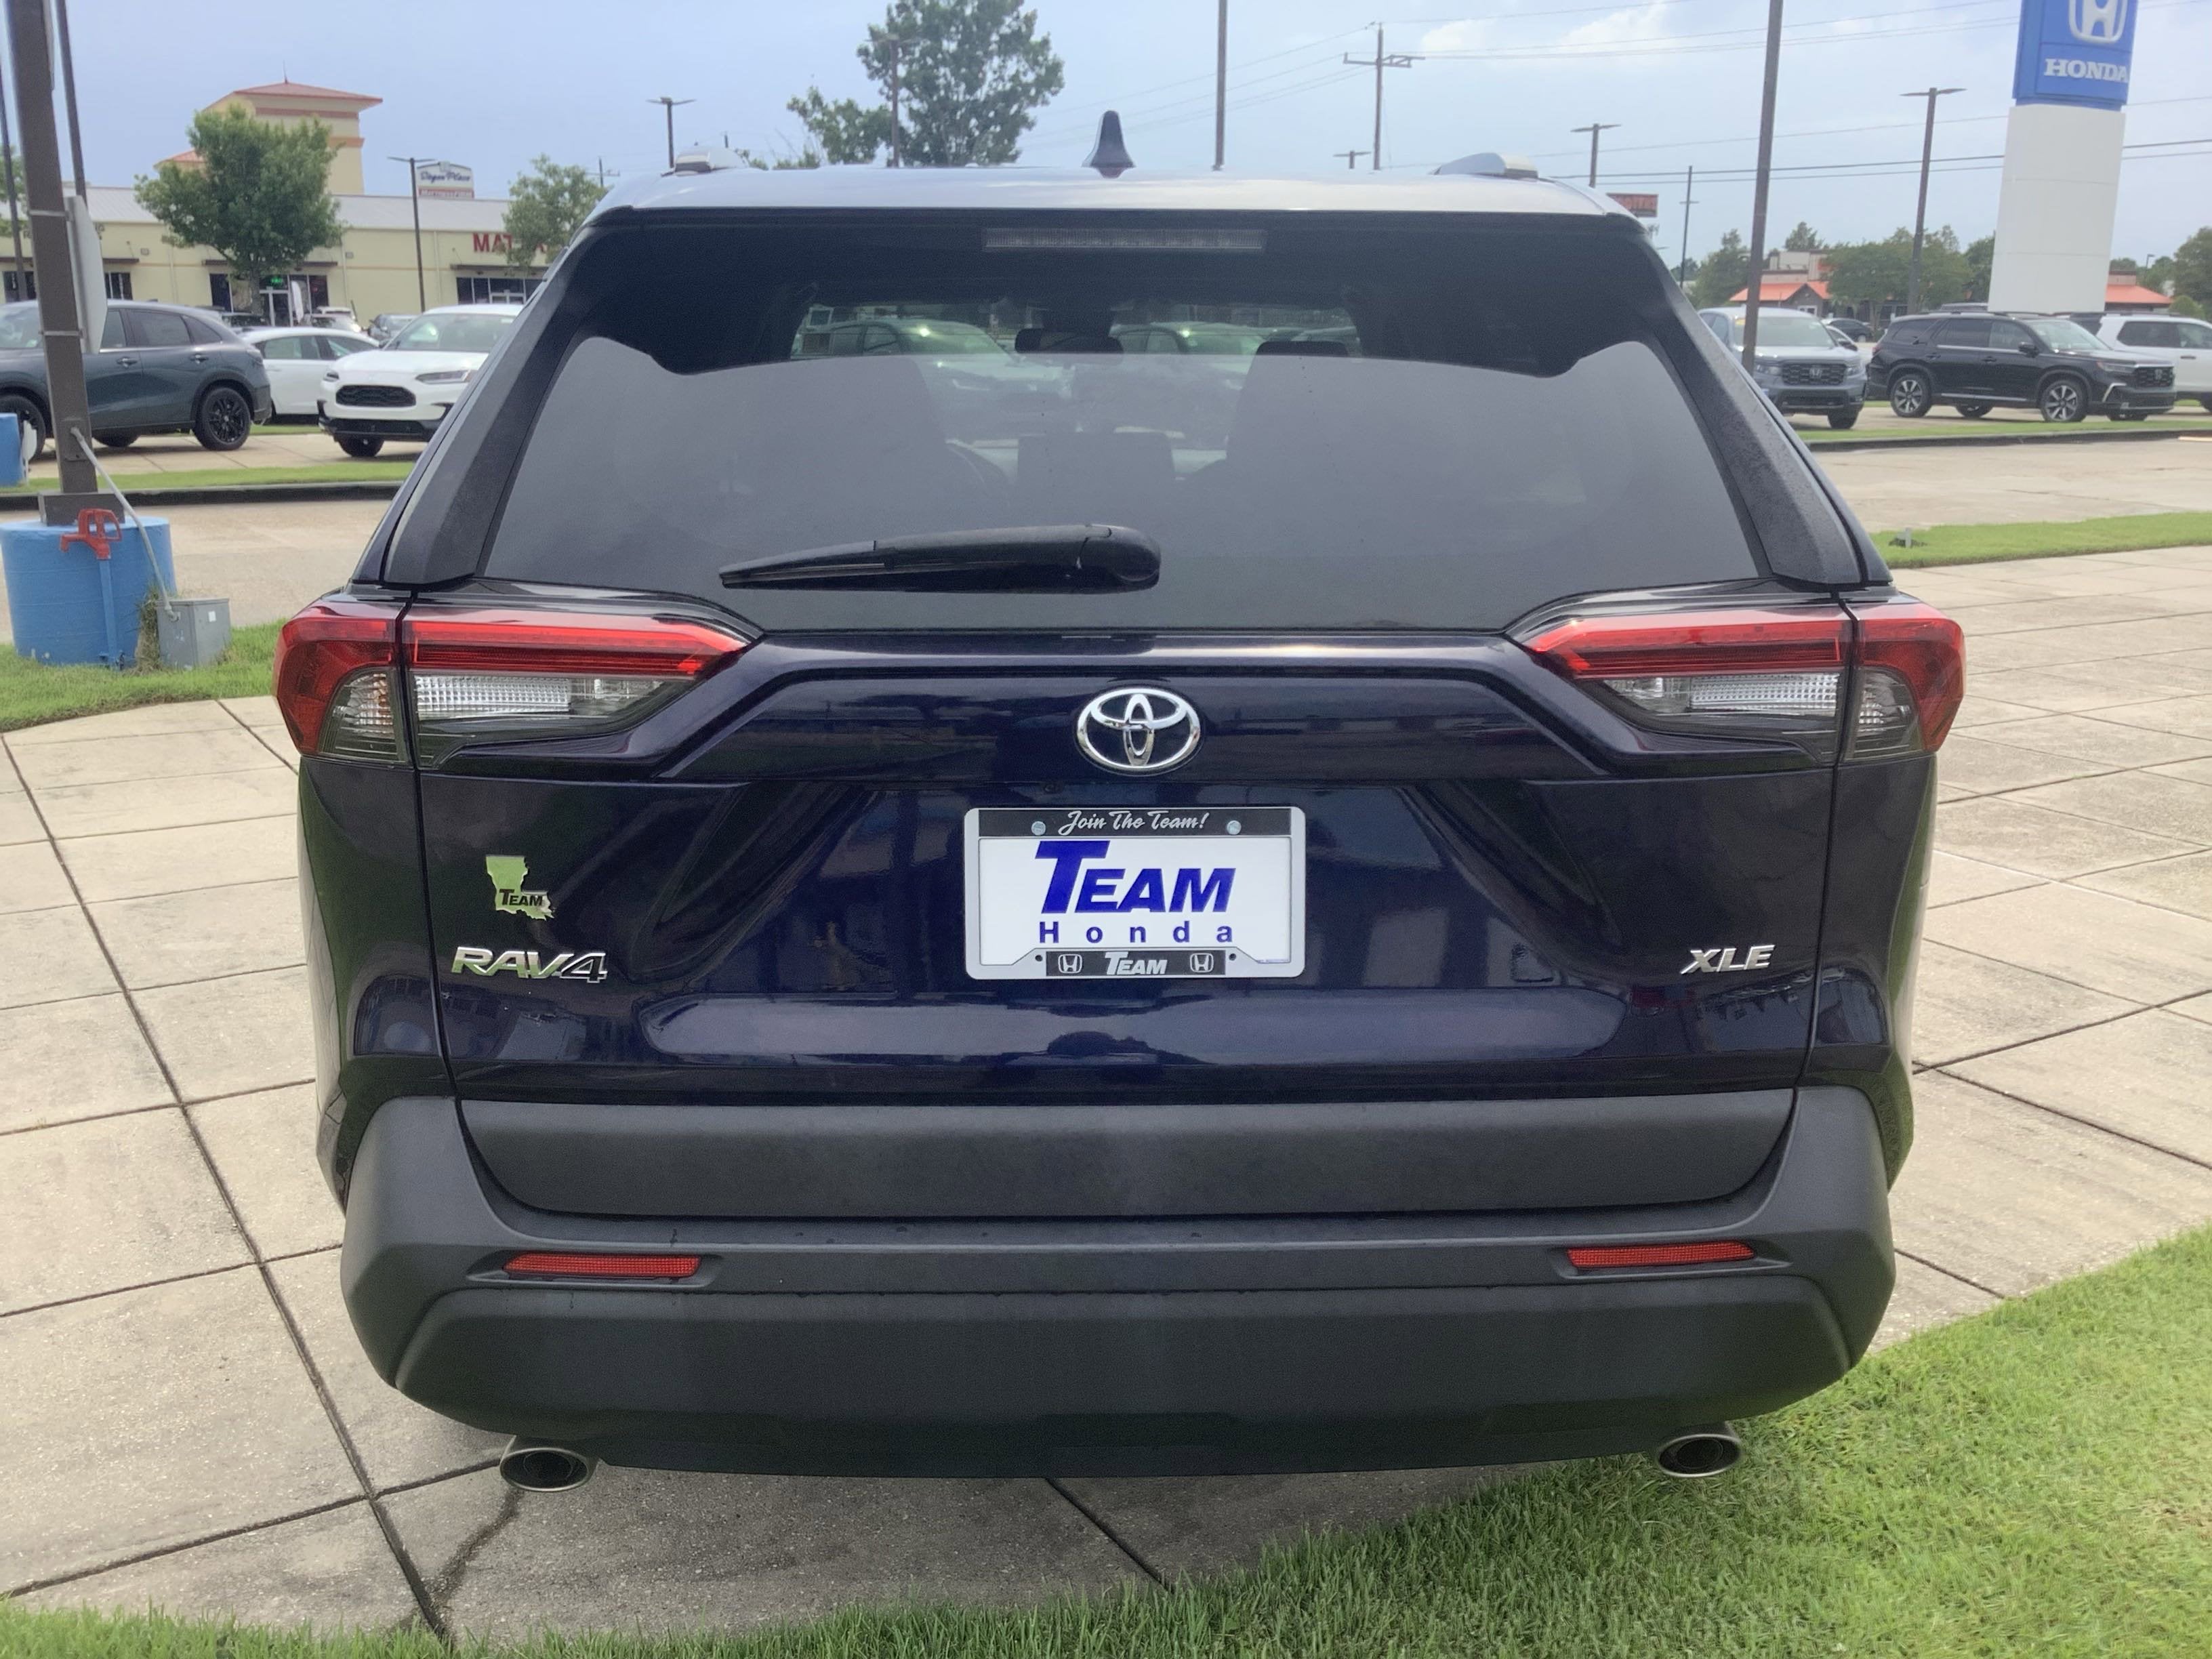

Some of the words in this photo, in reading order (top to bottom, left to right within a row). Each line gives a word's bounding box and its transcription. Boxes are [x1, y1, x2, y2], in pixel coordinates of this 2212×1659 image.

[2043, 58, 2129, 83] HONDA
[1058, 811, 1106, 836] Join
[1108, 811, 1145, 830] The
[1146, 811, 1210, 831] Team!
[1035, 840, 1236, 914] TEAM
[499, 888, 543, 906] TEAM
[1039, 920, 1233, 943] Honda
[451, 945, 609, 983] RAV4
[1104, 951, 1168, 976] TEAM
[1680, 943, 1776, 975] XLE
